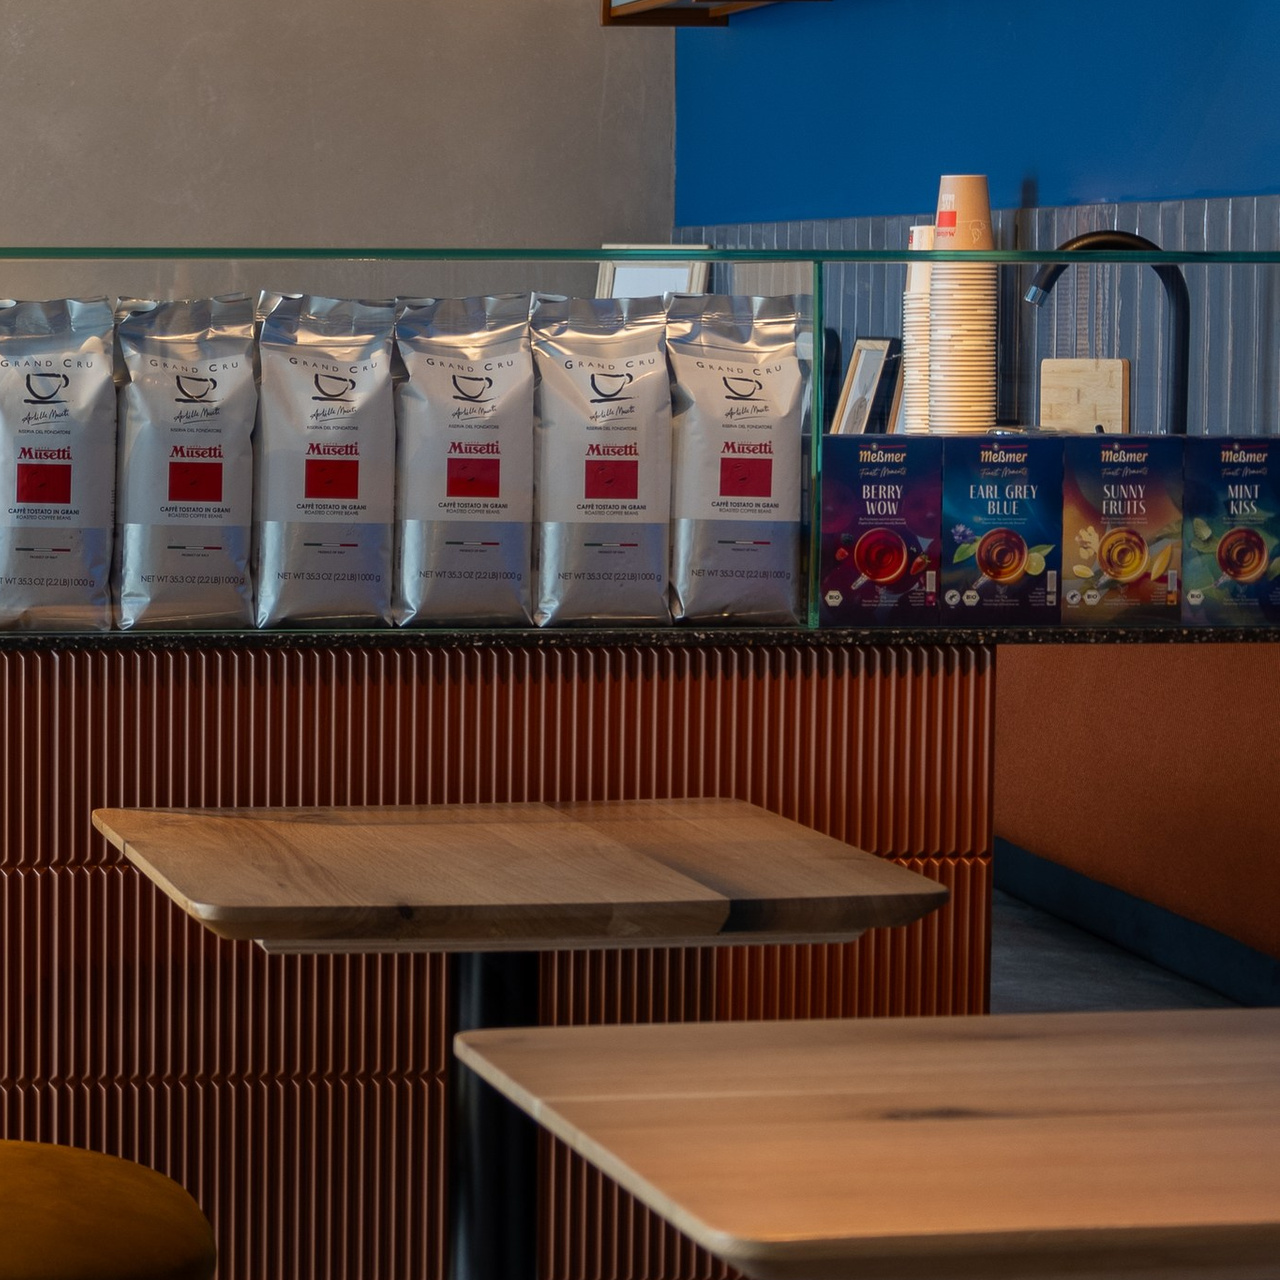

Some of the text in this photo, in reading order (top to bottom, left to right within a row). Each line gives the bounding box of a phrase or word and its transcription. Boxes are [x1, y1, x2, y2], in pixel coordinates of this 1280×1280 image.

[1, 359, 93, 368] GRAND CRU
[150, 360, 238, 373] GRAND CRU
[289, 358, 377, 374] GRAND CRU
[427, 358, 513, 372] GRAND CRU
[565, 359, 655, 370] GRAND CRU
[696, 362, 781, 376] GRAND CRU
[17, 446, 71, 459] Musetti
[170, 445, 223, 458] Musetti
[306, 442, 359, 456] Musetti
[447, 441, 501, 454] Musetti
[585, 443, 639, 456] Musetti
[721, 441, 773, 454] Musetti
[859, 450, 907, 462] Meßmer
[980, 450, 1028, 462] Meßmer
[1101, 450, 1148, 462] Meßmer
[1221, 450, 1268, 463] Meßmer
[862, 485, 903, 499] BERRY
[969, 485, 1038, 499] EARL GREY
[1104, 484, 1145, 499] SUNNY
[1228, 484, 1260, 499] MINT
[866, 501, 899, 515] WOW
[988, 501, 1019, 515] BLUE
[1102, 500, 1146, 515] FRUITS
[1230, 501, 1257, 514] KISS
[720, 570, 734, 578] 35.3
[735, 570, 745, 578] OZ
[34, 578, 45, 586] OZ
